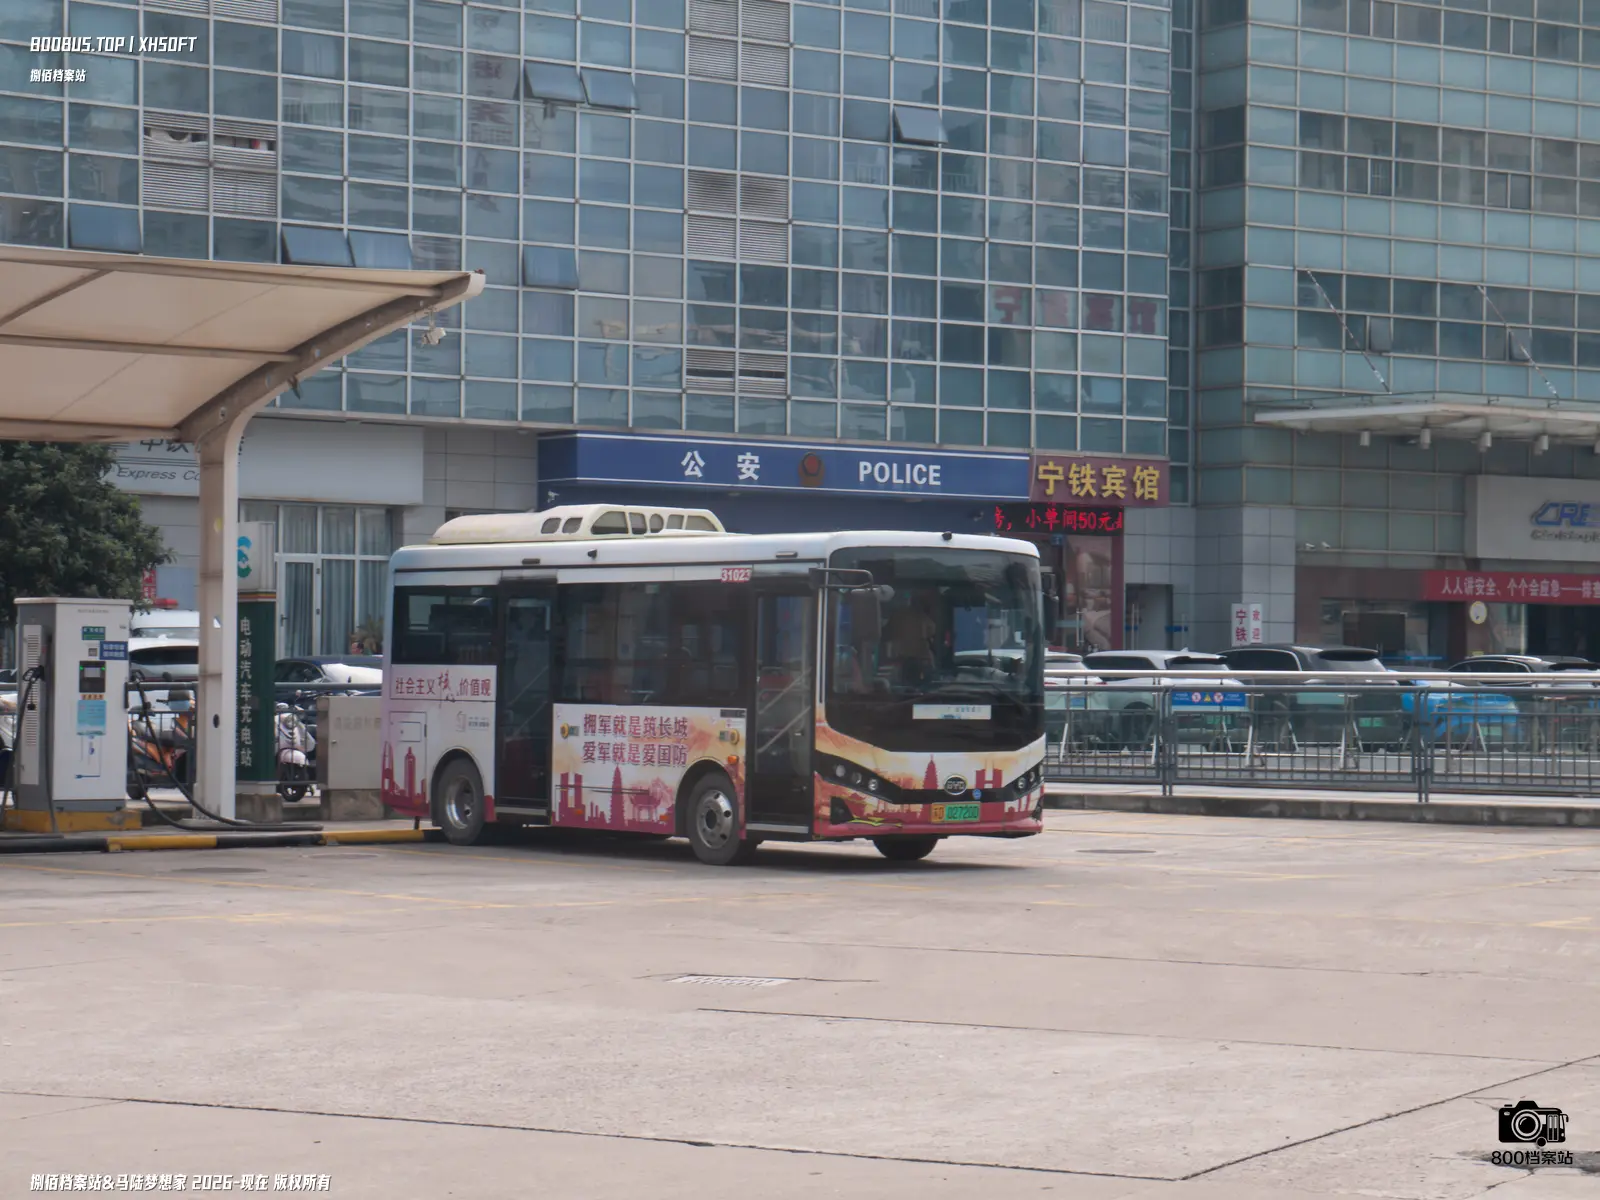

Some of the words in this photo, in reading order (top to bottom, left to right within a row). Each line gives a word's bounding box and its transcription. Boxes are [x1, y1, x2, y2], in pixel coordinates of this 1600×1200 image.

[117, 466, 177, 480] Express
[858, 461, 942, 486] POLICE
[1037, 461, 1161, 500] 宁铁宾馆
[721, 568, 752, 582] 31023
[1235, 608, 1247, 642] 宁铁
[239, 616, 252, 768] 电动汽车充电站
[583, 713, 689, 738] 拥军就是筑长城
[582, 741, 688, 767] 爱军就是爱国防
[946, 782, 966, 791] BYD
